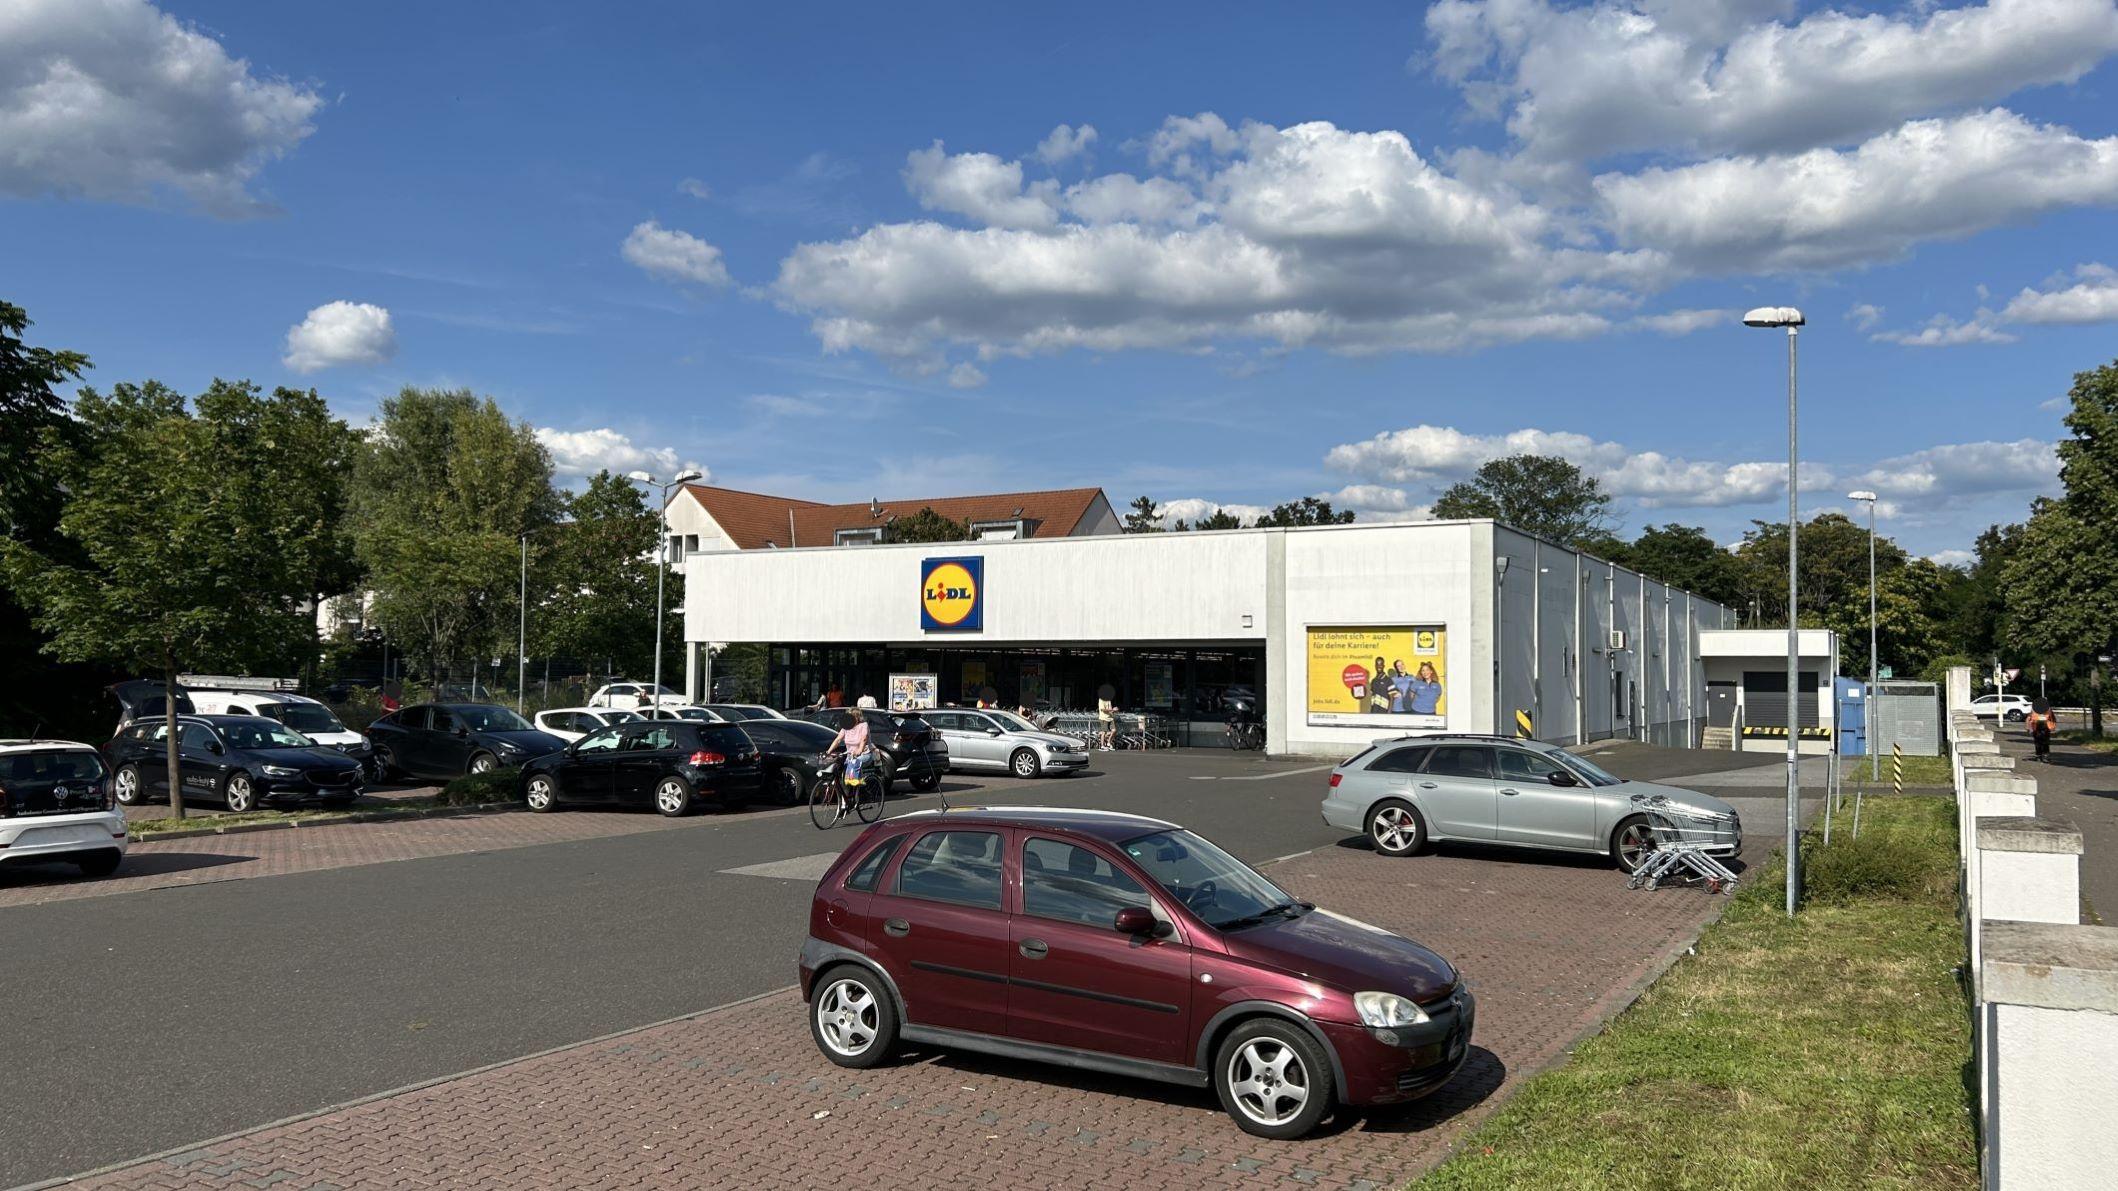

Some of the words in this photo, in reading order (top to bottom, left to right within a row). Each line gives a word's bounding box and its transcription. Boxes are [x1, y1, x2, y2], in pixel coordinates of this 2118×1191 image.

[1313, 632, 1327, 640] Lidl
[1328, 632, 1348, 640] lohnt
[1349, 632, 1365, 640] sich
[1372, 632, 1391, 640] auch
[1313, 641, 1324, 649] für
[1325, 641, 1346, 649] deine
[1347, 641, 1379, 649] Karriere!
